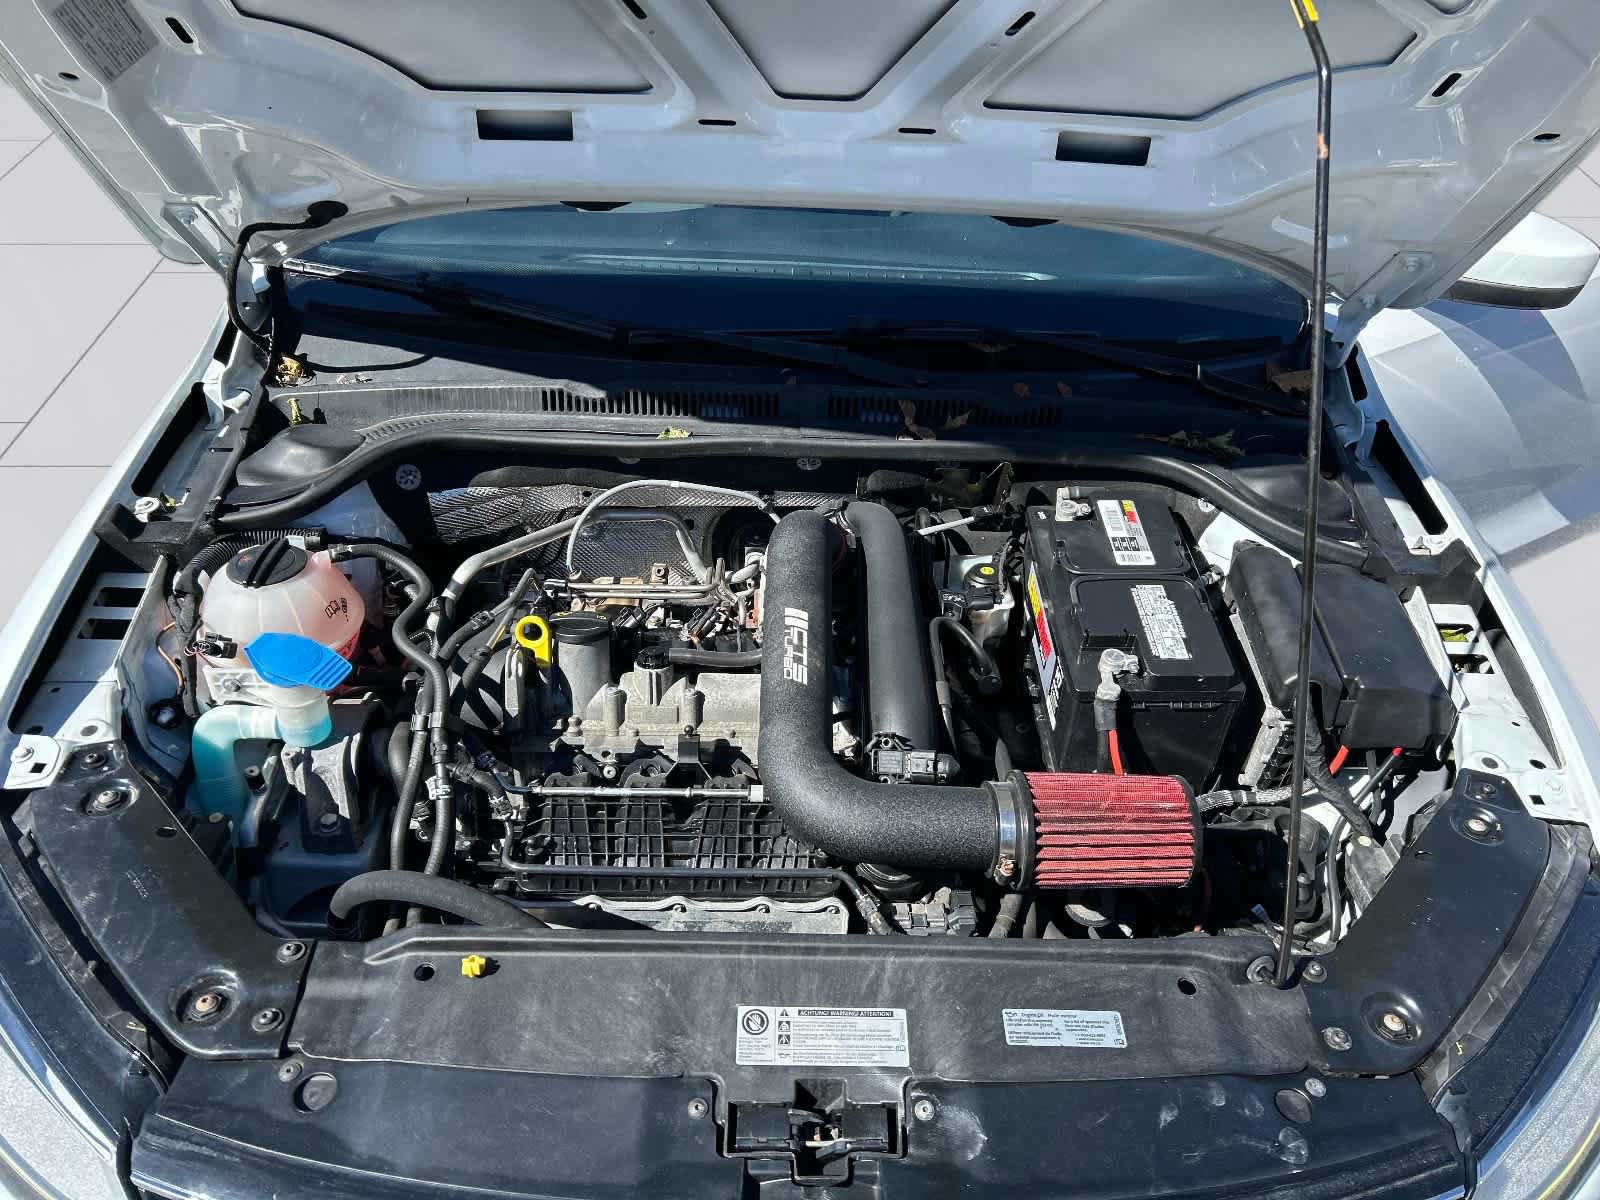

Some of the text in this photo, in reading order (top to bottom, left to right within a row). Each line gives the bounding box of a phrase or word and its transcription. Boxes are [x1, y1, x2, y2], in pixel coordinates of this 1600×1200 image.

[784, 627, 792, 679] TURBO
[792, 625, 808, 685] CTS
[859, 1010, 892, 1018] ATTENTION!
